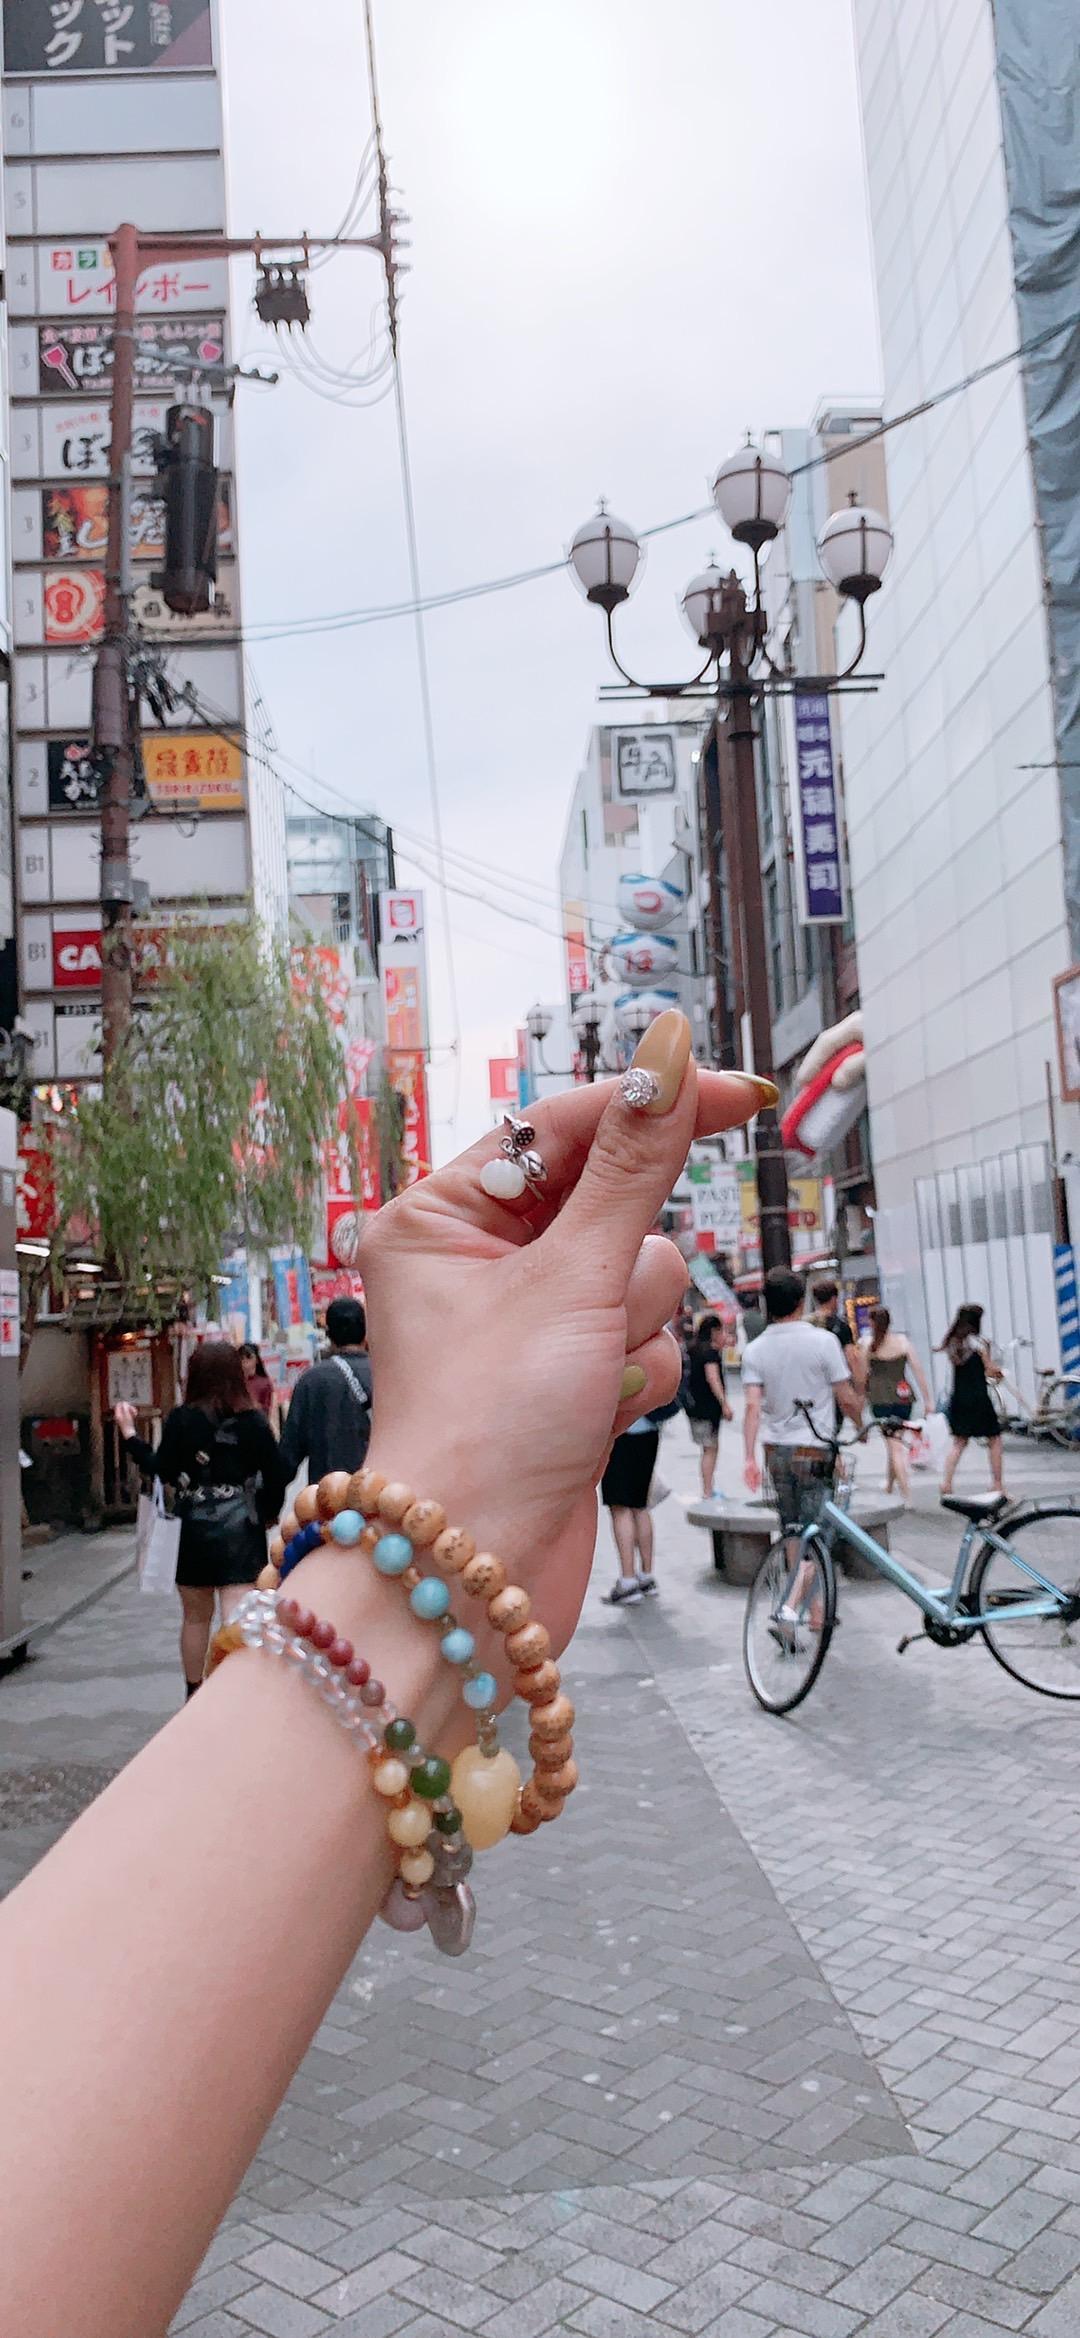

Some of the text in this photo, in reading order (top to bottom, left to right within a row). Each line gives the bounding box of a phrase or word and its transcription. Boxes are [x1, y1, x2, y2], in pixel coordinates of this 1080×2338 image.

[94, 0, 136, 65] ット
[29, 768, 39, 788] 2
[25, 855, 44, 874] B1
[28, 944, 47, 961] B1
